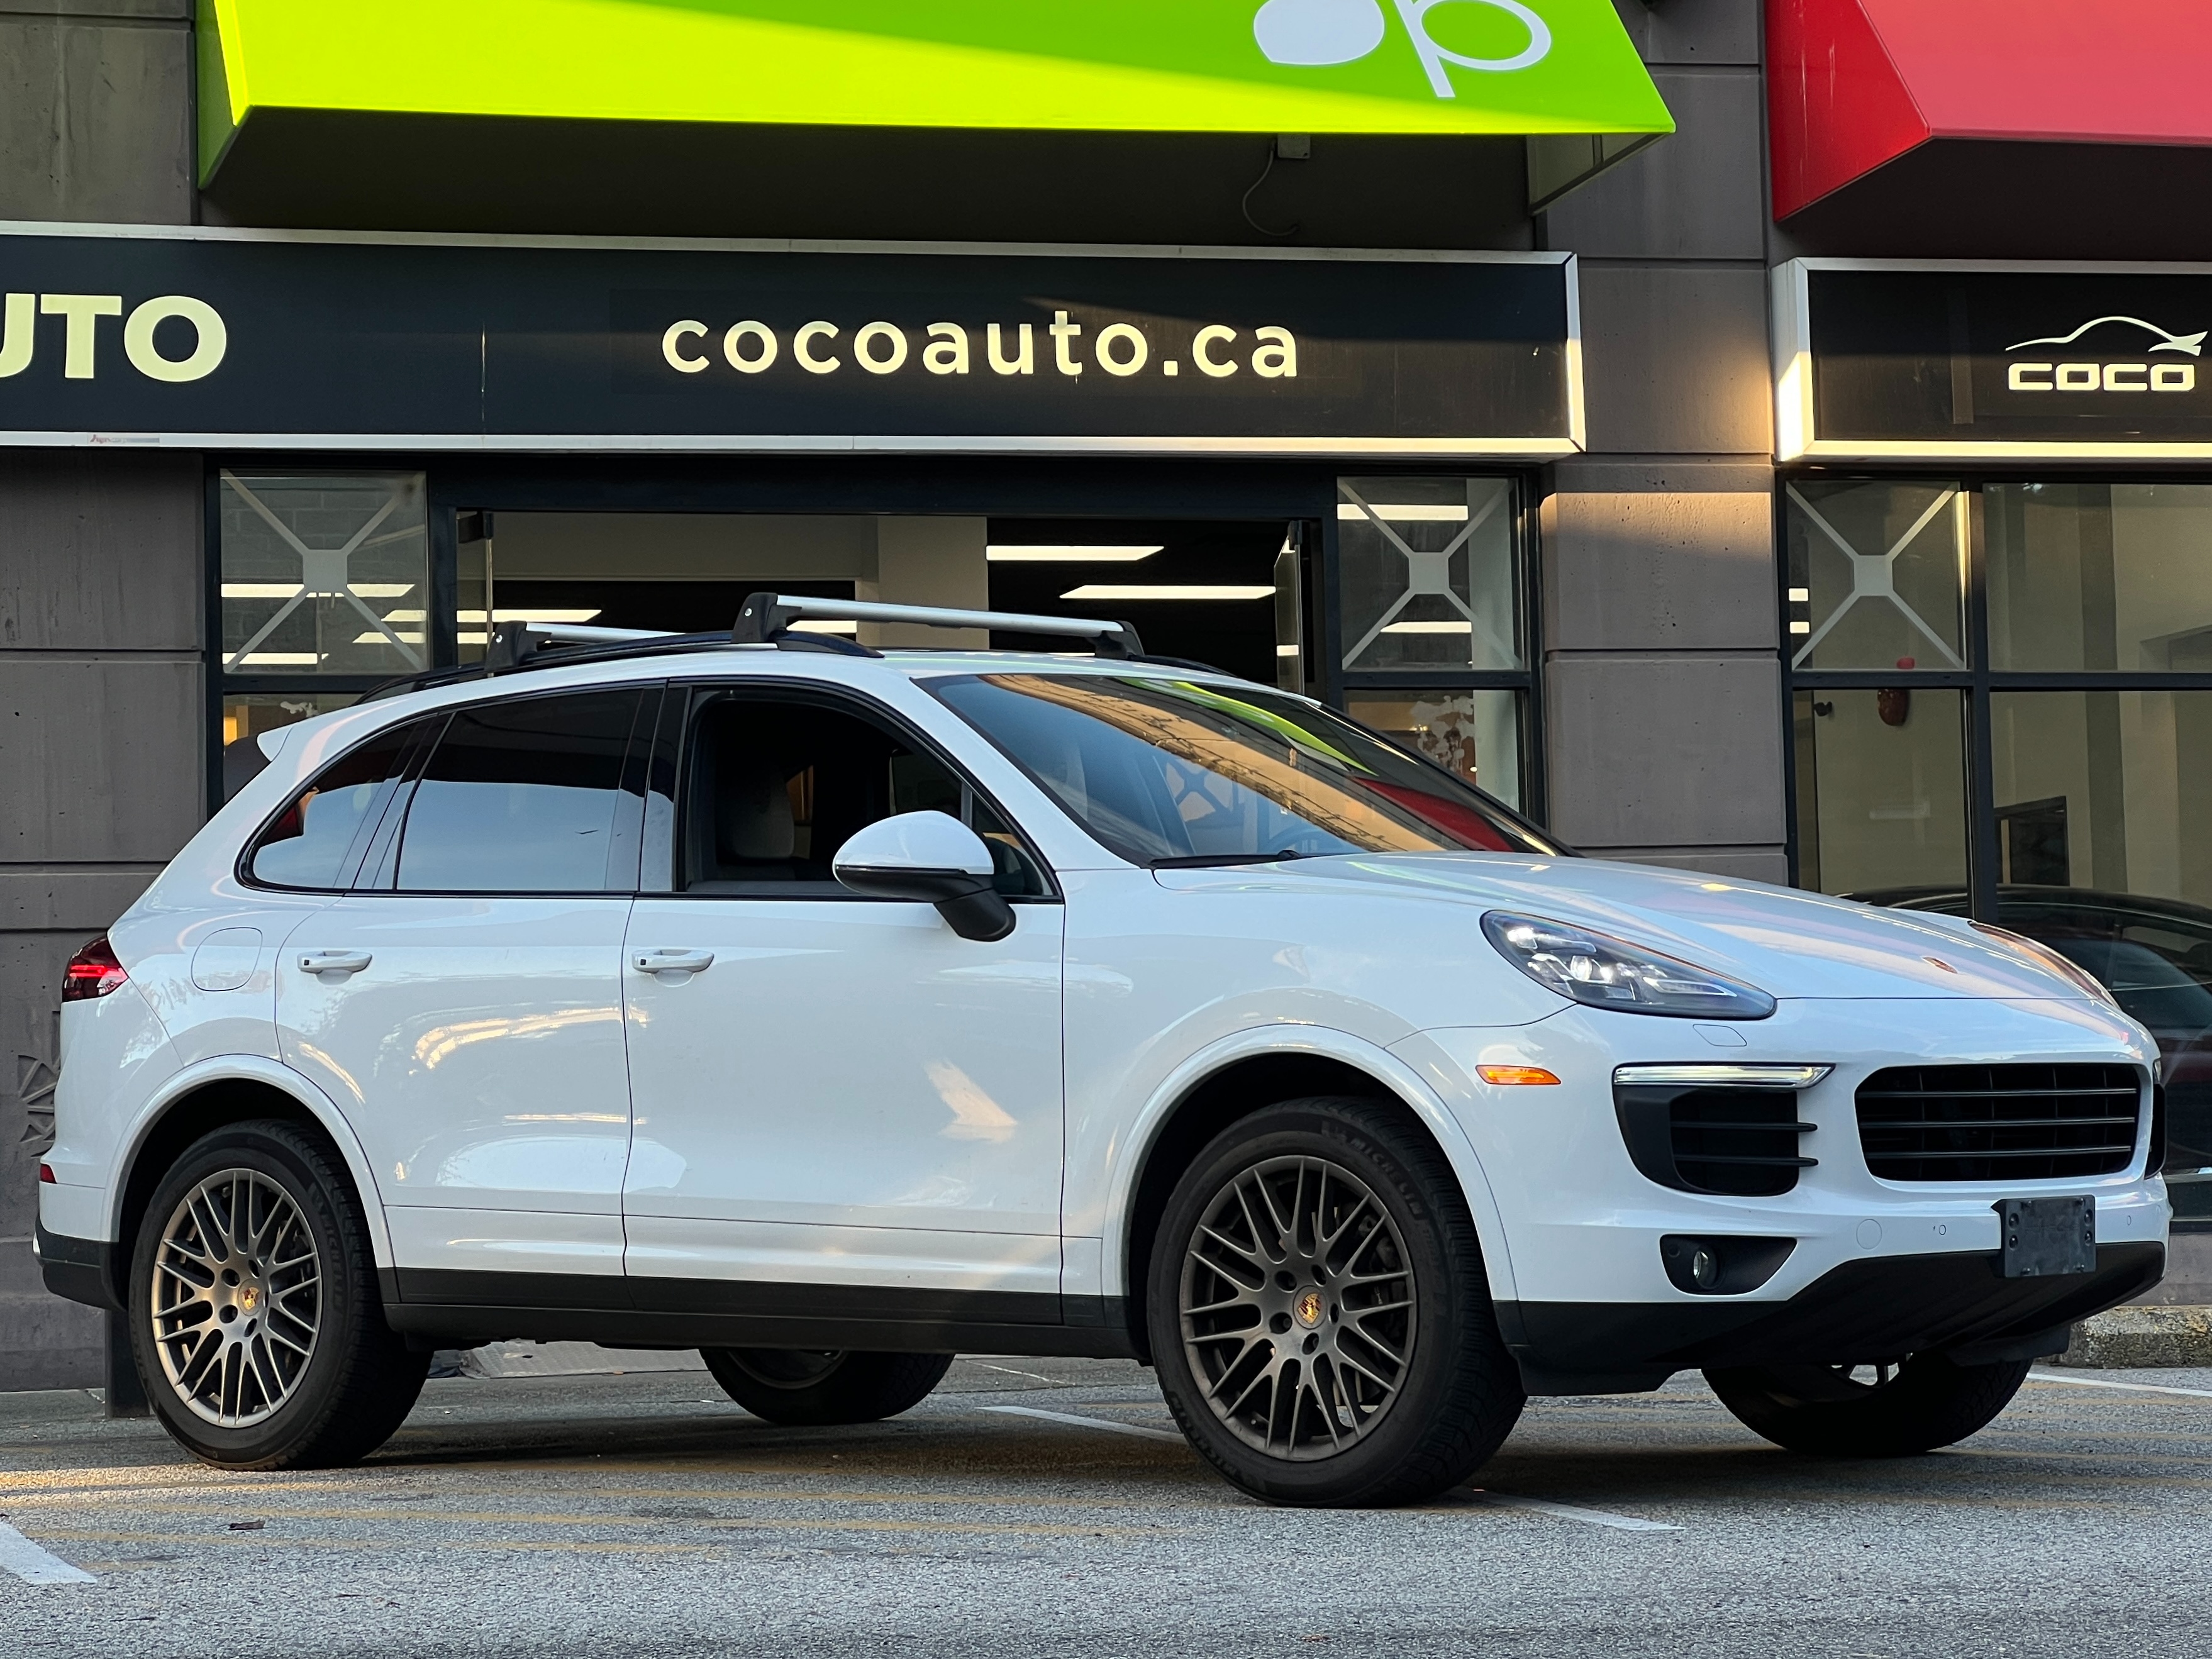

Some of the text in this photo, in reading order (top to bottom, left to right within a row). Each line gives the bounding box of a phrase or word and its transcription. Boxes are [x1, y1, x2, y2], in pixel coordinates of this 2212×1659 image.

[662, 311, 1298, 377] cocoauto.ca
[2008, 363, 2195, 391] COCO
[1350, 1136, 1424, 1215] MICHELIN
